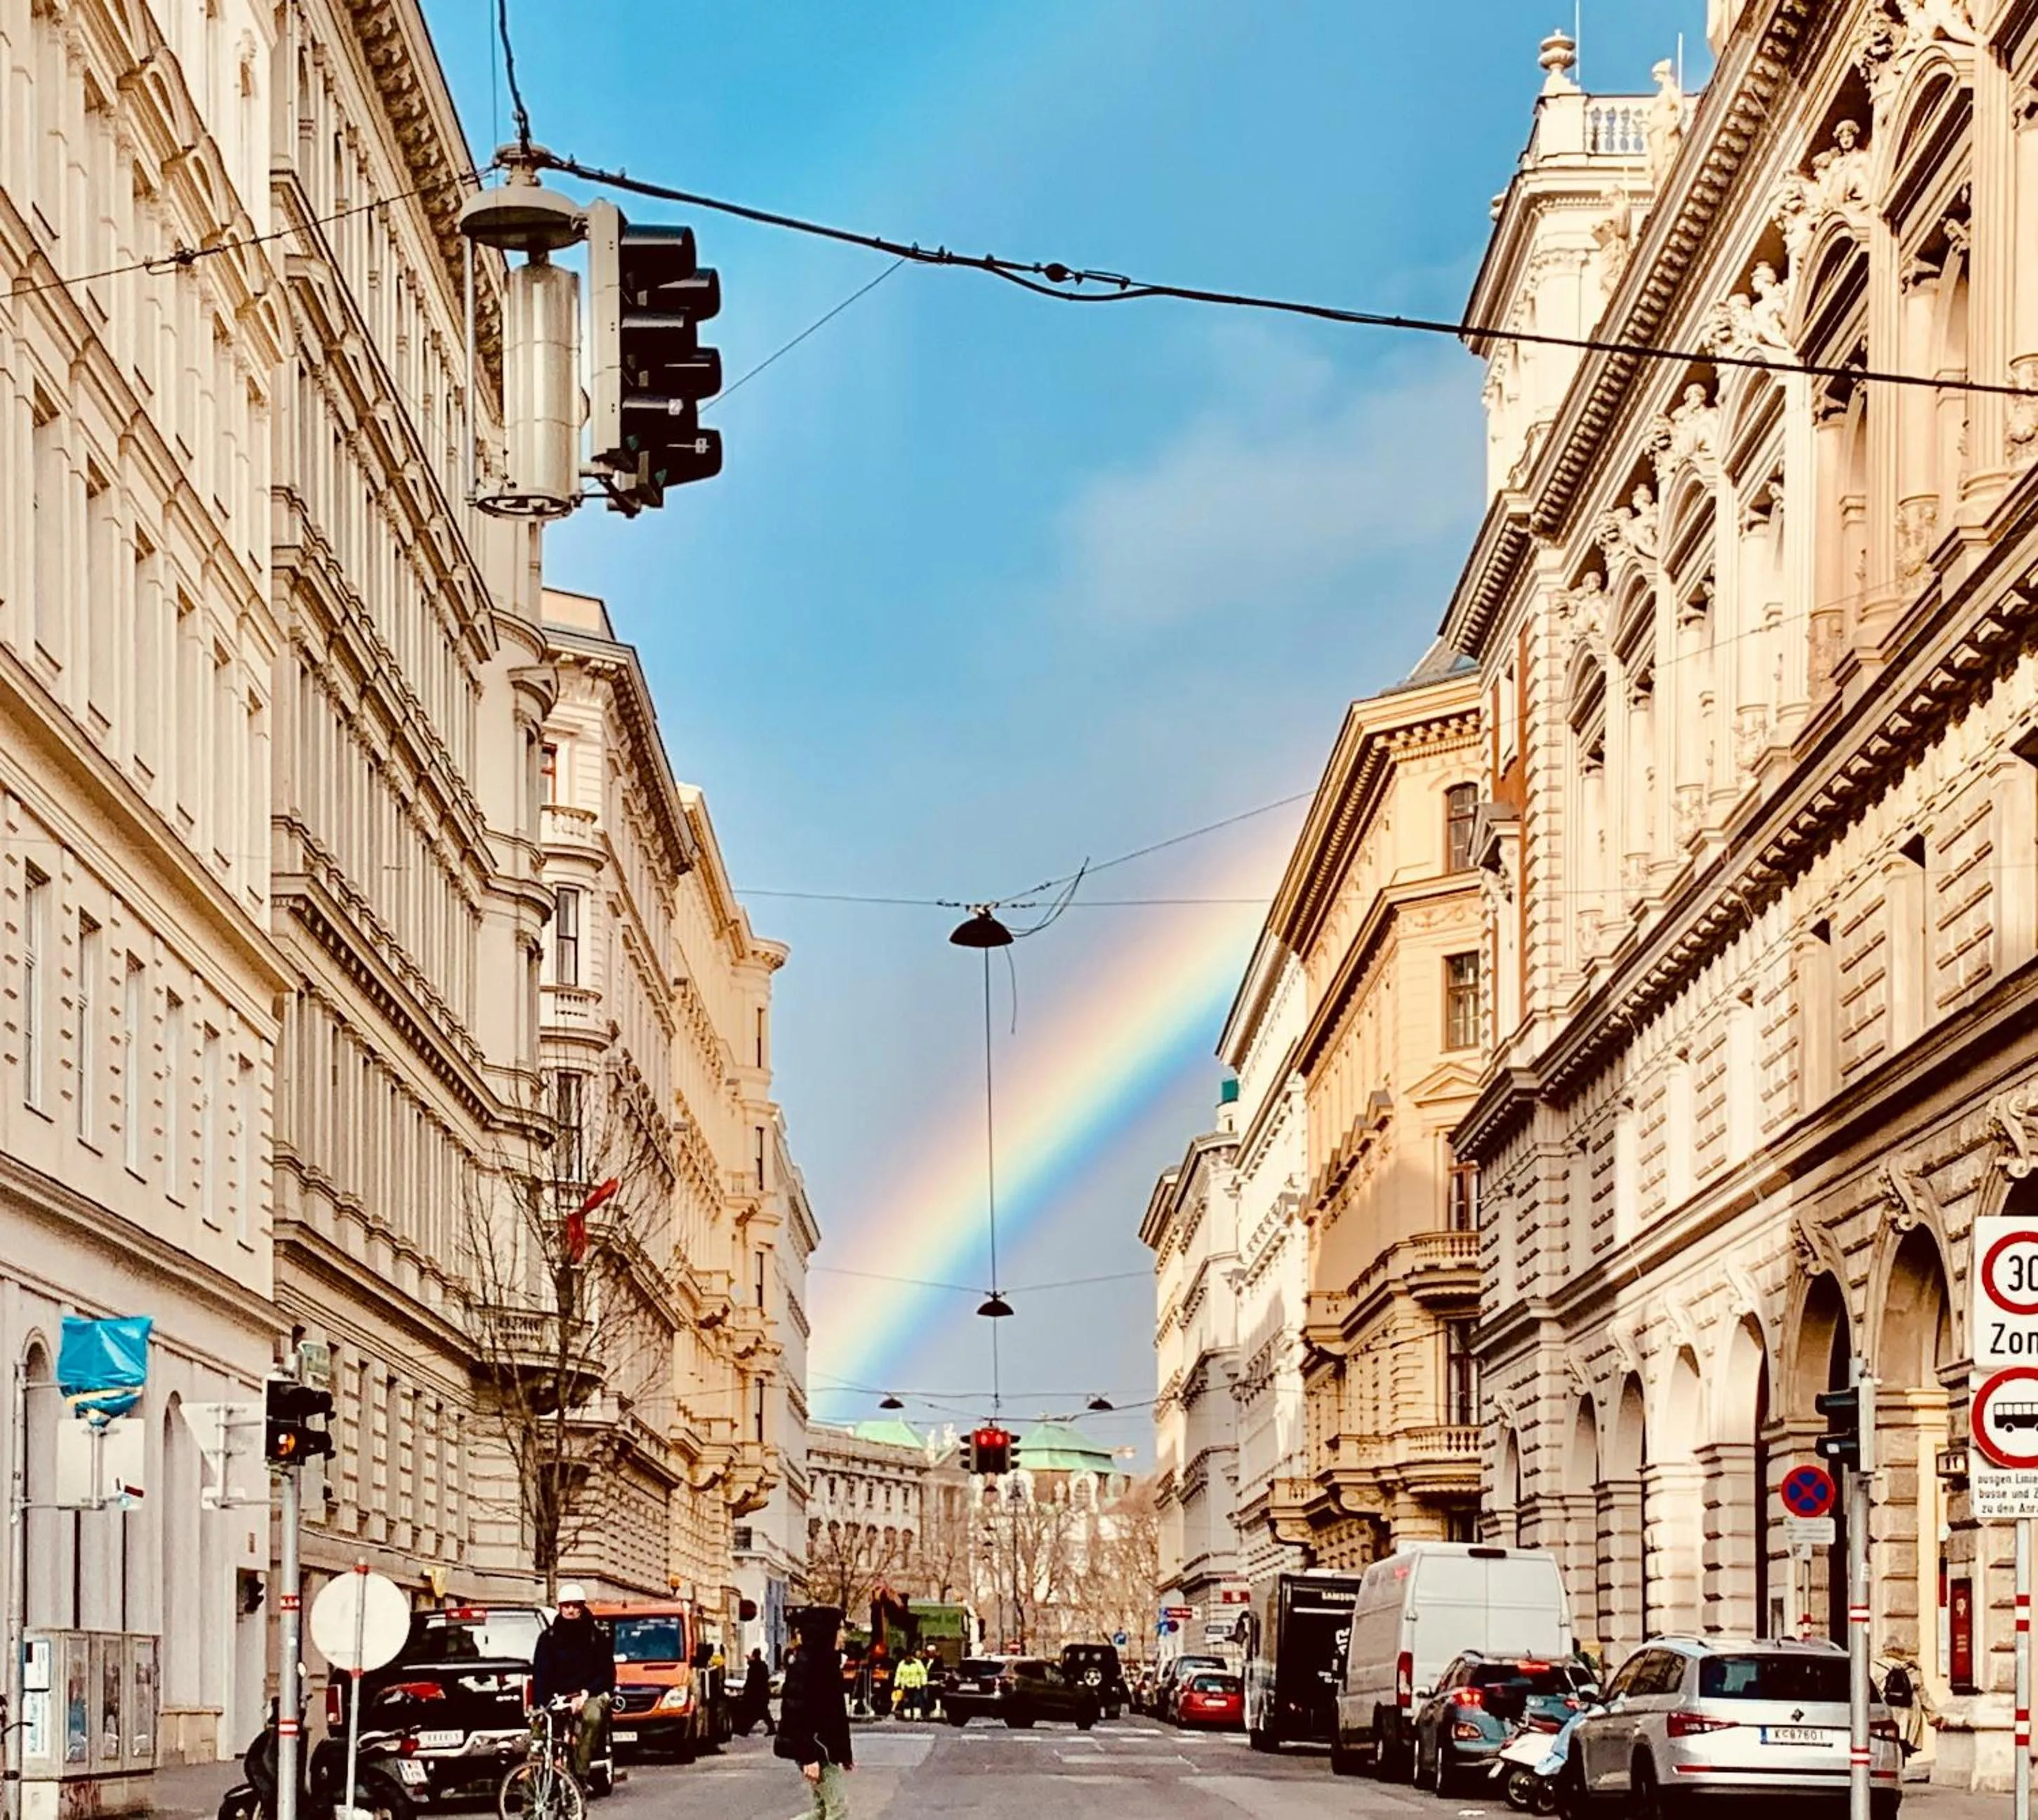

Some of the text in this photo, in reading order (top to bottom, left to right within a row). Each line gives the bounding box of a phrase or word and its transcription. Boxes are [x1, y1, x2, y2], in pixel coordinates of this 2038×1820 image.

[2008, 1255, 2038, 1291] 30
[2012, 1489, 2029, 1499] und
[1982, 1503, 2038, 1513] zu den Anr
